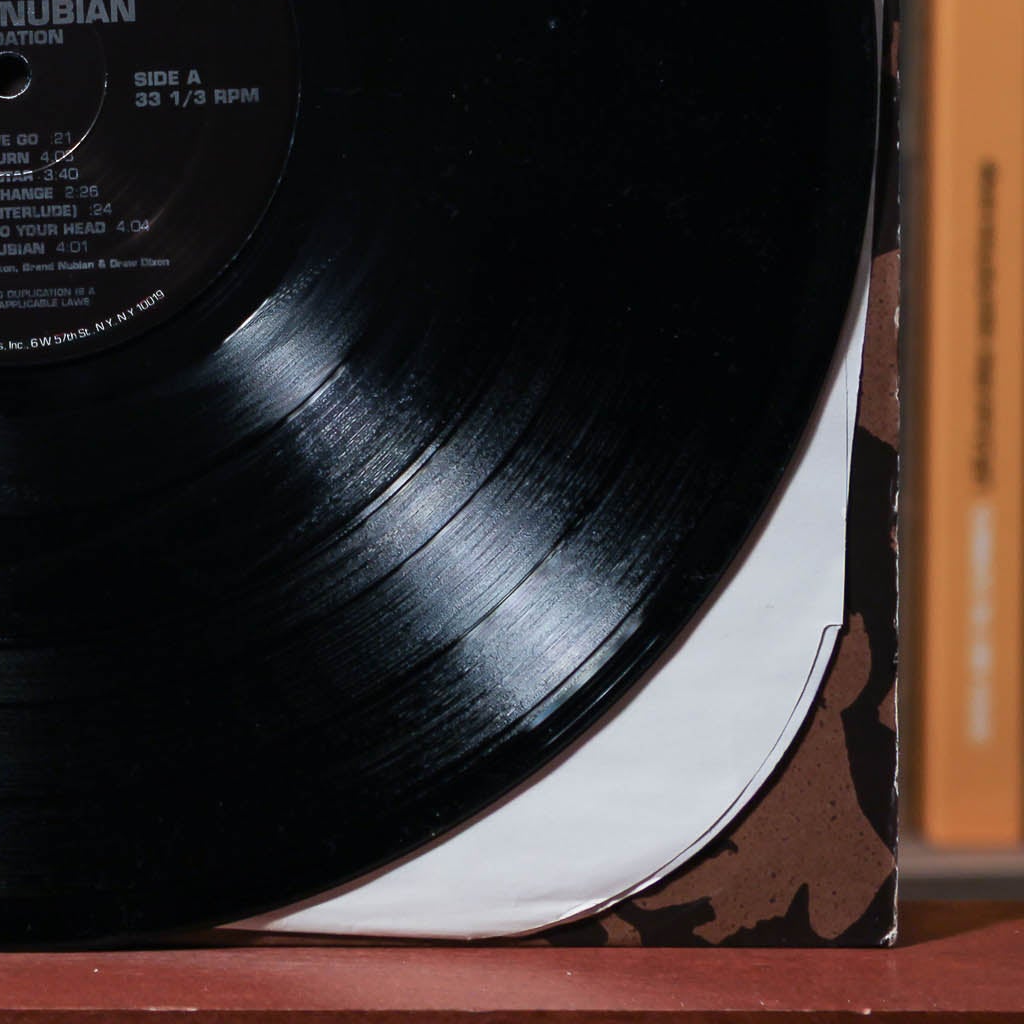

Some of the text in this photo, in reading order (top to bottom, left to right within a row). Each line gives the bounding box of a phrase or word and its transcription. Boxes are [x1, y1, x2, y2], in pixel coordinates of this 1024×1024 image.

[134, 69, 202, 87] SIDE A
[135, 88, 260, 108] 33 1/3 RPM
[16, 133, 39, 145] GO
[65, 186, 99, 199] 2:26
[89, 203, 112, 216] :24
[16, 224, 58, 237] YOUR
[64, 221, 106, 235] HEAD
[56, 240, 88, 253] 4:01
[58, 260, 94, 271] Nubian
[7, 287, 71, 298] DUPLICATION
[88, 286, 96, 295] A
[136, 289, 165, 312] 10019
